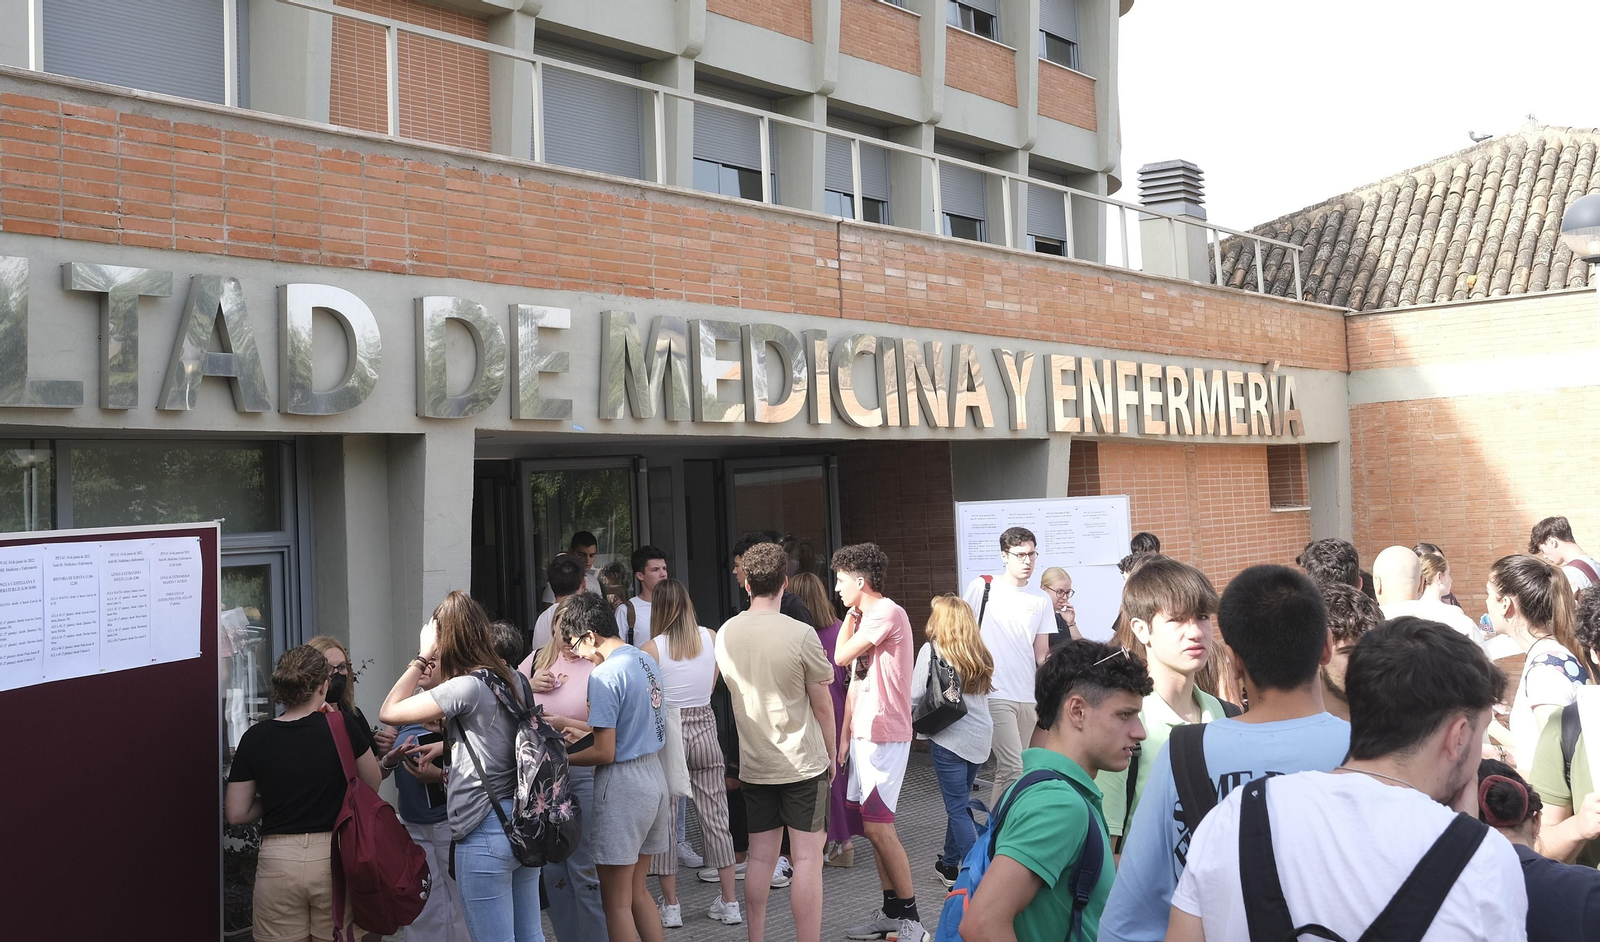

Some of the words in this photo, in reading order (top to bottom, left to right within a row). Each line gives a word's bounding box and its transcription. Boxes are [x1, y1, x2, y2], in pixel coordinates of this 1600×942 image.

[416, 296, 573, 420] DE
[600, 310, 994, 430] MEDICINA
[993, 347, 1035, 431] Y
[1044, 352, 1306, 437] ENFERMERÍA
